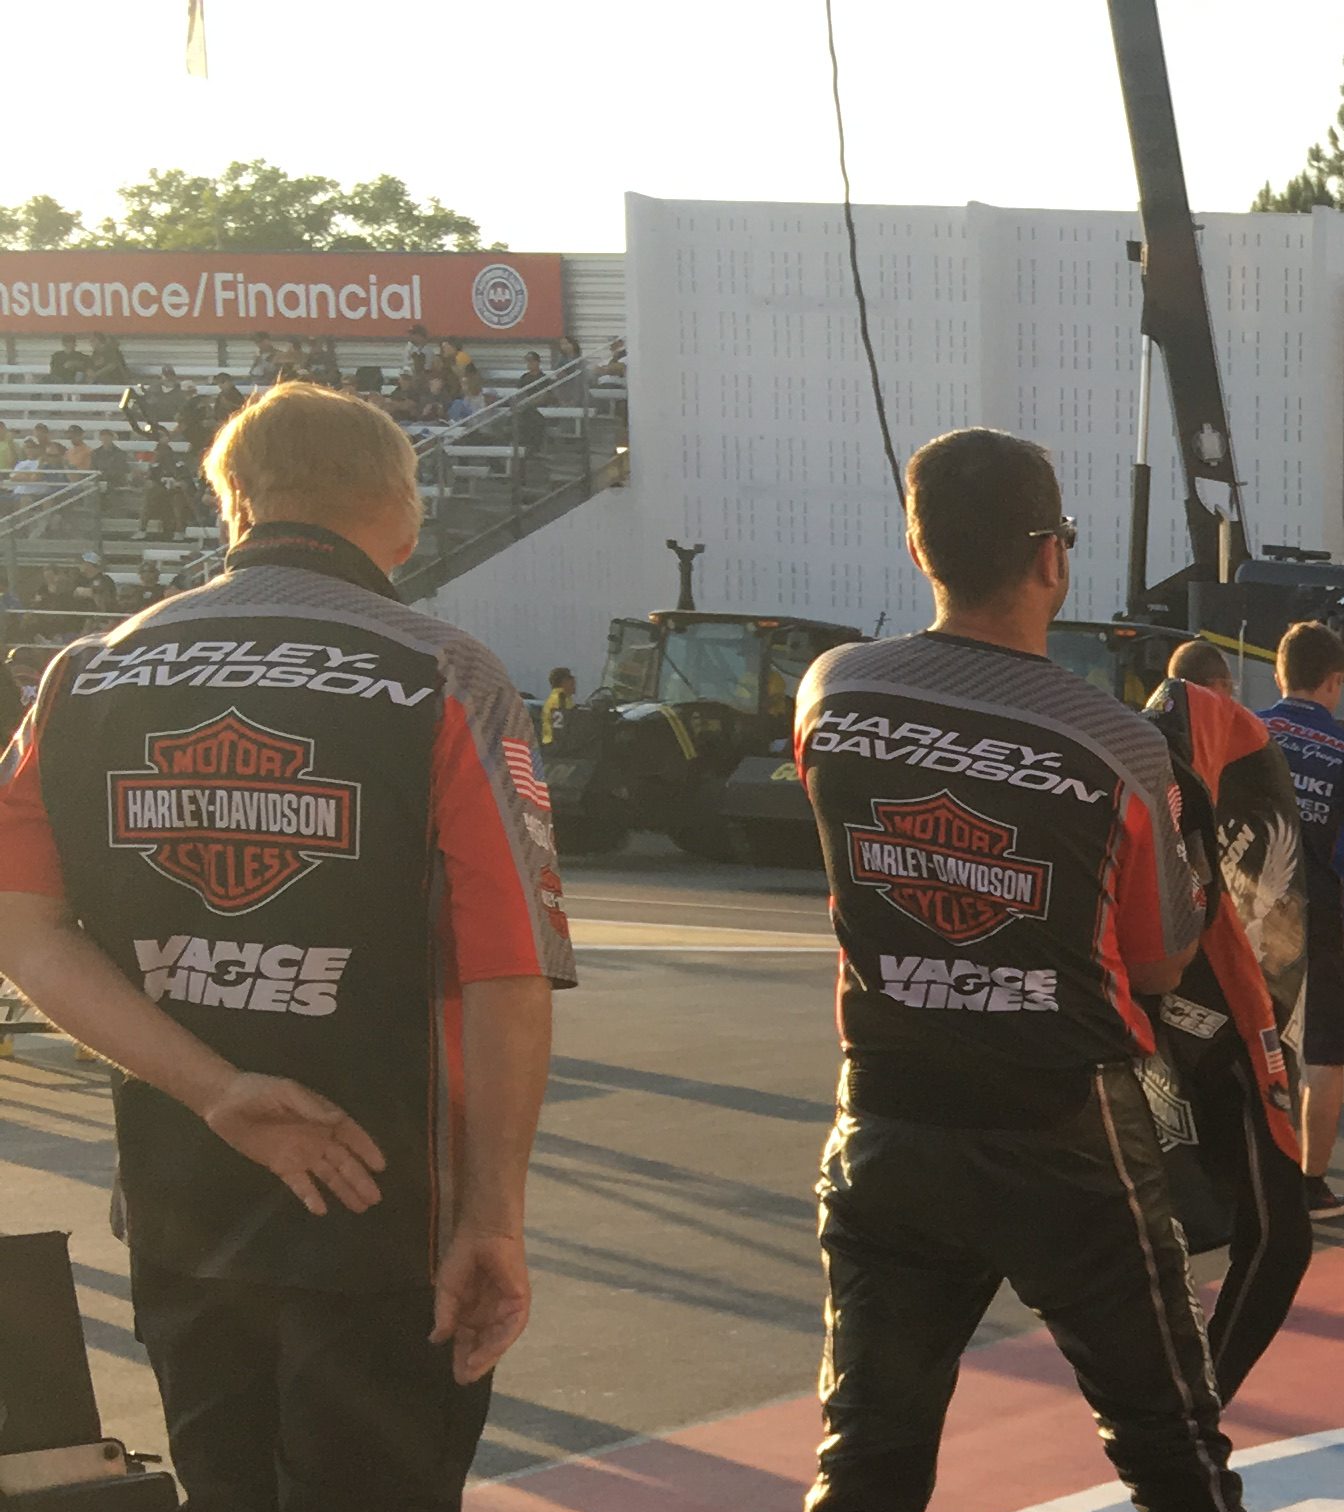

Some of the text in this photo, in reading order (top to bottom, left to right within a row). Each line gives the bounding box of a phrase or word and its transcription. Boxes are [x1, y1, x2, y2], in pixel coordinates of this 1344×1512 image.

[0, 272, 422, 320] nsurance/Financial
[86, 641, 380, 670] HARLEY-
[71, 665, 435, 706] DAVIDSON
[173, 733, 288, 778] MOTOR
[817, 710, 1063, 768] HARLEY-
[810, 731, 1108, 803] DAVIDSON
[128, 789, 335, 839] HARLEY-DAVIDSON
[892, 813, 991, 853] MOTOR
[178, 844, 282, 897] CYCLES
[859, 840, 1034, 904] HARLEY-DAVIDSON
[133, 934, 352, 981] VANCE
[879, 954, 1059, 993] VANCE
[143, 969, 337, 1017] HINES
